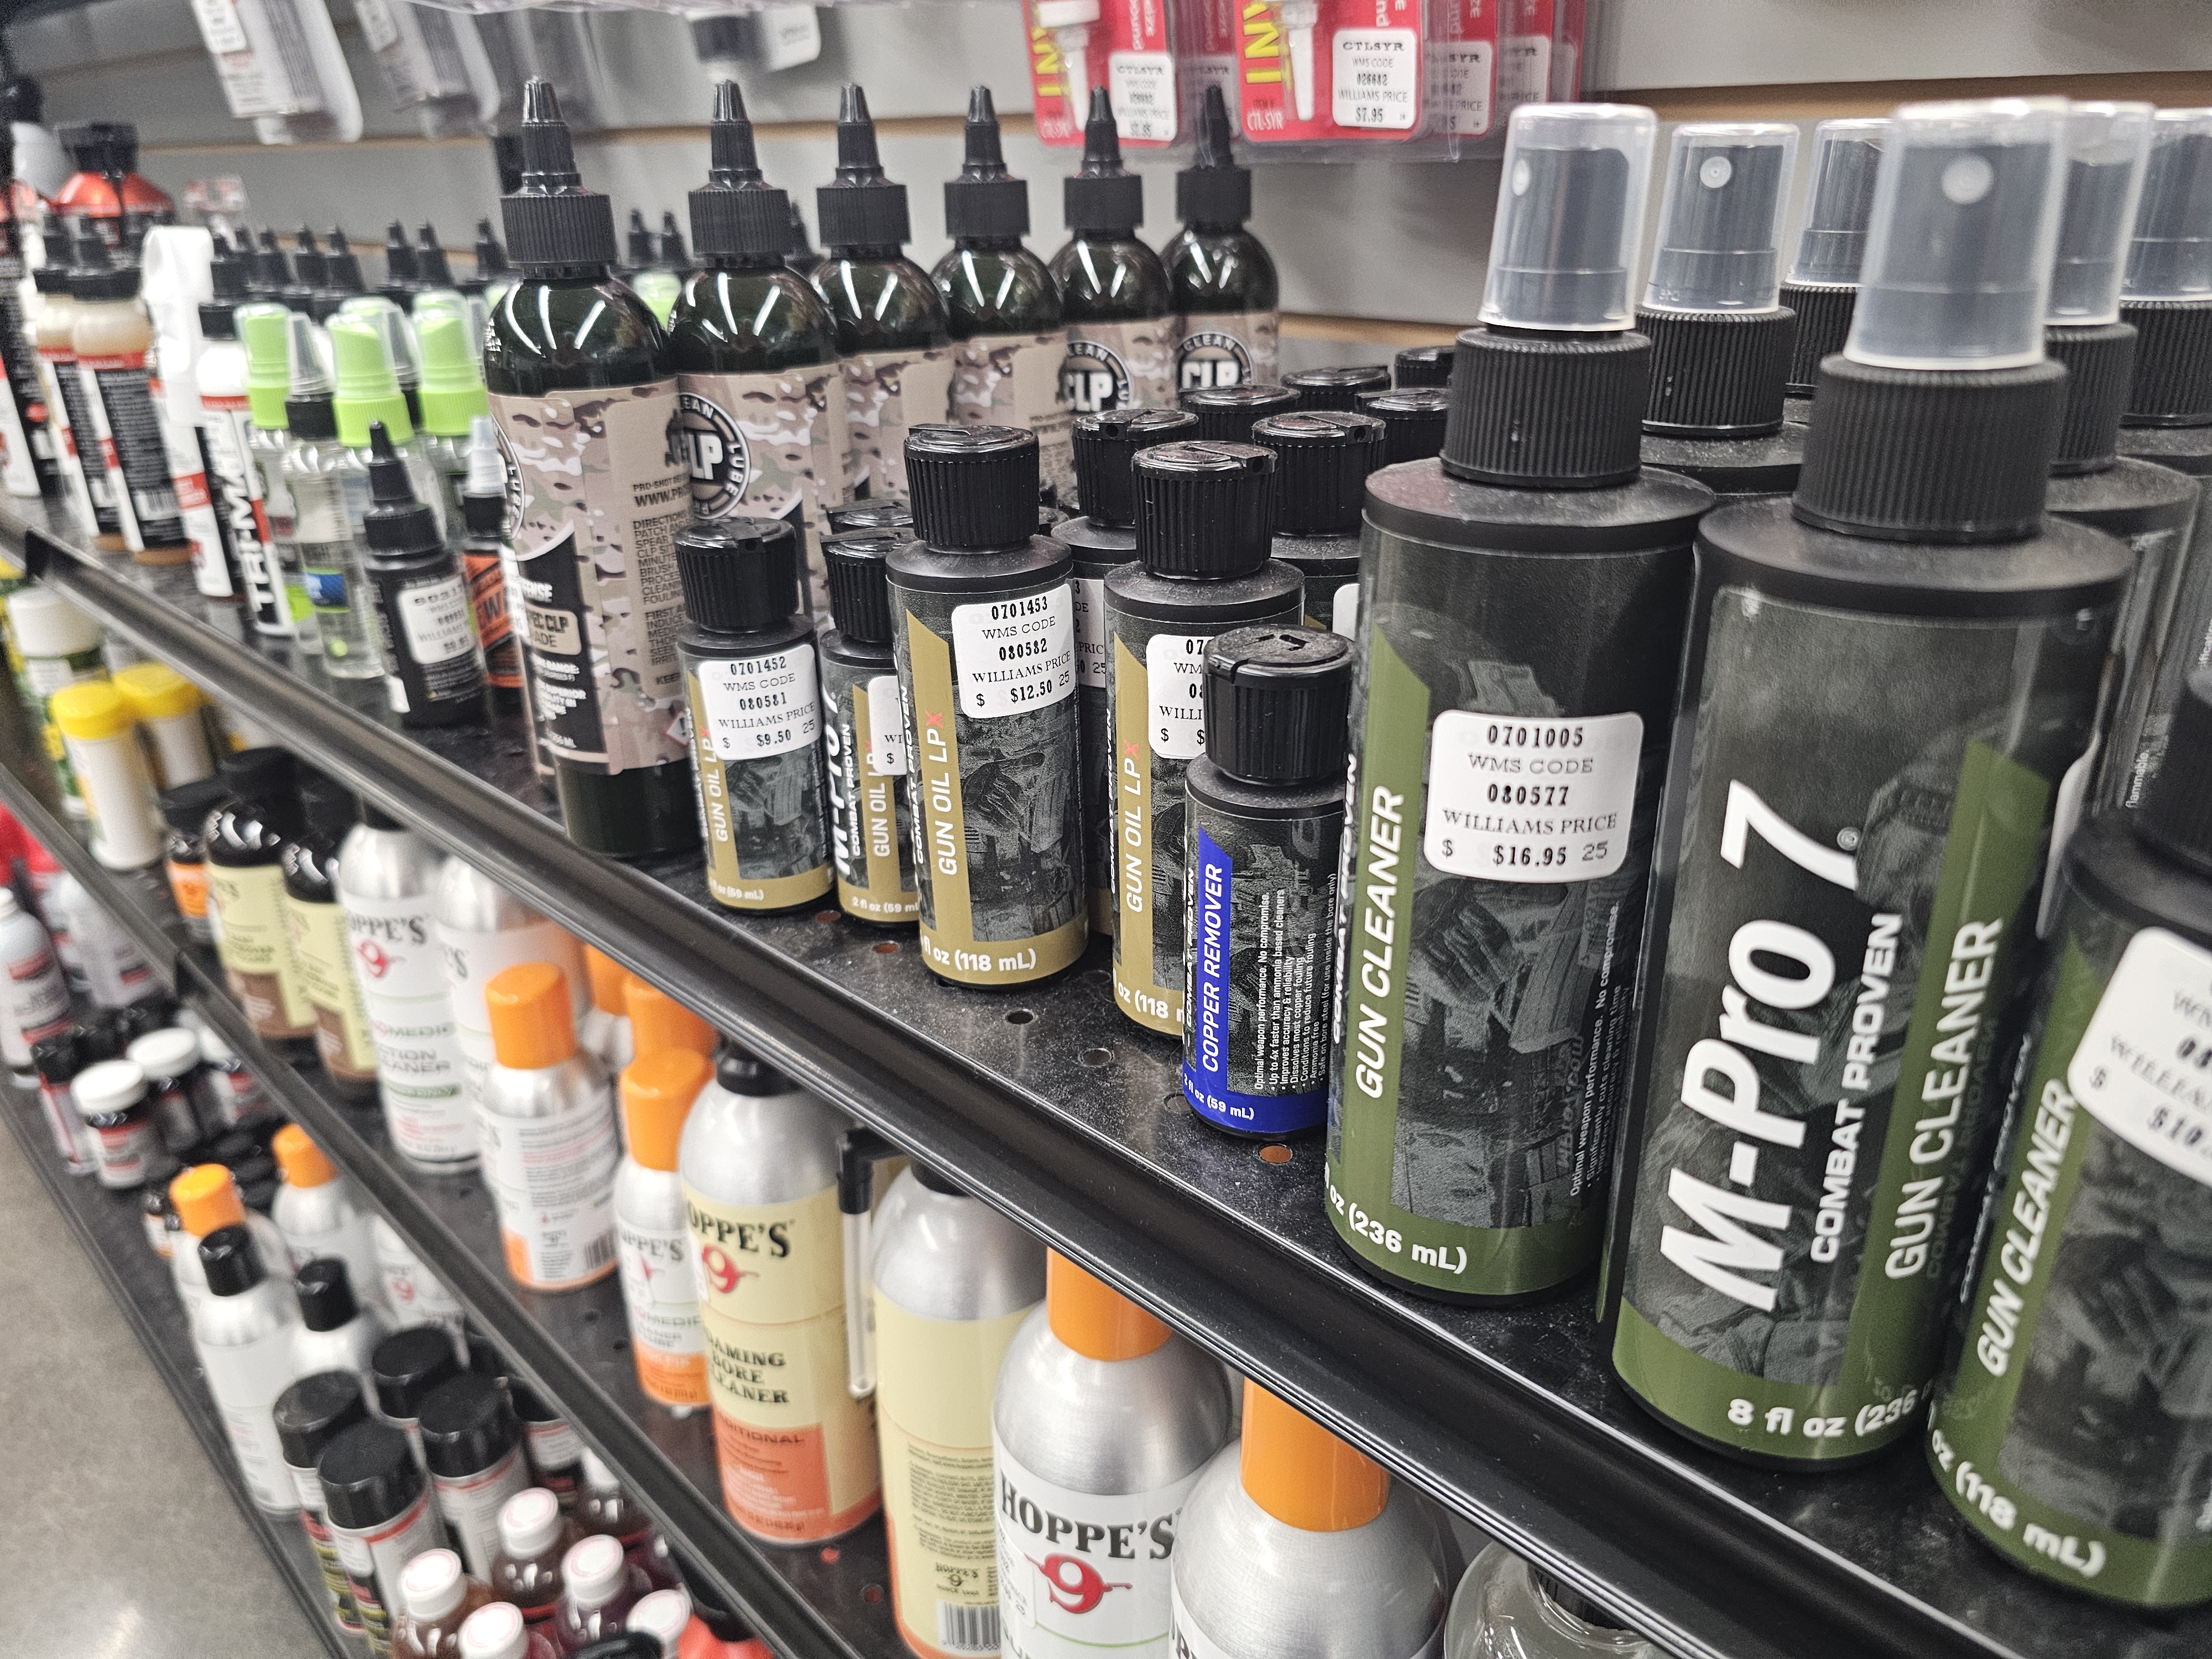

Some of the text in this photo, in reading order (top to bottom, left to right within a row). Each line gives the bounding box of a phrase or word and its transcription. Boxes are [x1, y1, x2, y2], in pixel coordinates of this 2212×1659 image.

[1343, 41, 1404, 51] CTLSYR
[1371, 58, 1395, 68] CODE
[1338, 88, 1409, 103] WILLIAMS PRICE
[1355, 107, 1383, 123] $7.95
[1183, 335, 1235, 351] CLEAN
[727, 443, 744, 496] LUBE
[634, 525, 667, 539] PATCH
[635, 535, 669, 549] SPEAR
[637, 547, 656, 559] CLP
[545, 614, 569, 634] CLP
[992, 596, 1048, 620] 0701453
[982, 615, 1056, 639] WMS CODE
[731, 656, 786, 675] 0701452
[999, 638, 1047, 661] 080582
[1078, 641, 1104, 655] PRIC
[723, 673, 795, 691] WMS CODE
[972, 650, 1071, 683] WILLIAMS PRICE
[1173, 662, 1202, 674] WM
[739, 692, 787, 710] 080581
[976, 670, 1070, 708] $ $12.50 25
[718, 702, 816, 728] WILLIAMS PRICE
[1159, 706, 1203, 720] WILLI
[723, 719, 815, 749] $ $9.50 25
[1161, 728, 1169, 743] $
[1488, 725, 1583, 748] 0701005
[886, 753, 895, 765] $
[901, 685, 924, 864] COMBAT PROVEN
[1468, 752, 1594, 774] WMS CODE
[839, 724, 861, 857] COMBAT PROVEN
[1488, 784, 1569, 807] 080577
[2125, 749, 2150, 809] flammable.
[707, 769, 728, 842] GUN OIL
[869, 782, 891, 857] GUN OIL
[1442, 807, 1619, 835] WILLIAMS PRICE
[931, 773, 957, 875] GUN OIL
[1124, 805, 1142, 913] GUN OIL
[1442, 838, 1608, 867] $ $16.95 25
[727, 886, 764, 901] (59 mL)
[1327, 873, 1337, 895] only)
[1333, 753, 1357, 1044] COMBAT PROVEN
[852, 896, 881, 911] 2 fl oz
[1326, 897, 1334, 919] bore
[933, 947, 1036, 972] oz (118 mL)
[1355, 785, 1405, 1099] GUN CLEANER
[1202, 863, 1223, 1073] COPPER REMOVER
[1282, 956, 1295, 995] reliability
[1118, 982, 1169, 1019] oz (118
[1254, 892, 1270, 1089] Optimal weapon performance. No compromise.
[1269, 889, 1285, 1084] Up to 4x faster than ammonia based cleaners
[1322, 983, 1330, 998] (for
[1290, 957, 1306, 1083] Dissolves most copper fouling
[1300, 933, 1317, 1081] Conditions to reduce future fouling
[1282, 1006, 1293, 1045] accuracy
[1909, 917, 2003, 1165] CLEANER
[1310, 1021, 1319, 1078] Ammonia free
[1321, 1045, 1327, 1055] on
[1570, 900, 1619, 1196] Optimal weapon performance. No compromise.
[1659, 780, 1857, 1312] M-Pro 7
[1280, 1047, 1290, 1084] Improves
[1587, 985, 1621, 1180] Significantly cuts cleaning time
[1184, 1073, 1254, 1120] 2 fl oz (59 mL)
[1810, 913, 1903, 1263] COMBAT PROVEN
[688, 1201, 790, 1259] OPPE'S
[1330, 1185, 1467, 1275] oz (236 mL)
[1885, 1175, 1943, 1279] GUN
[1976, 1280, 2023, 1376] GUN
[2000, 1078, 2078, 1285] CLEANER
[1728, 1390, 1917, 1437] 8 fl oz (236
[1000, 1467, 1176, 1559] HOPPE'S
[1932, 1429, 2106, 1578] oz (118 mL)
[1033, 1552, 1124, 1614] 9
